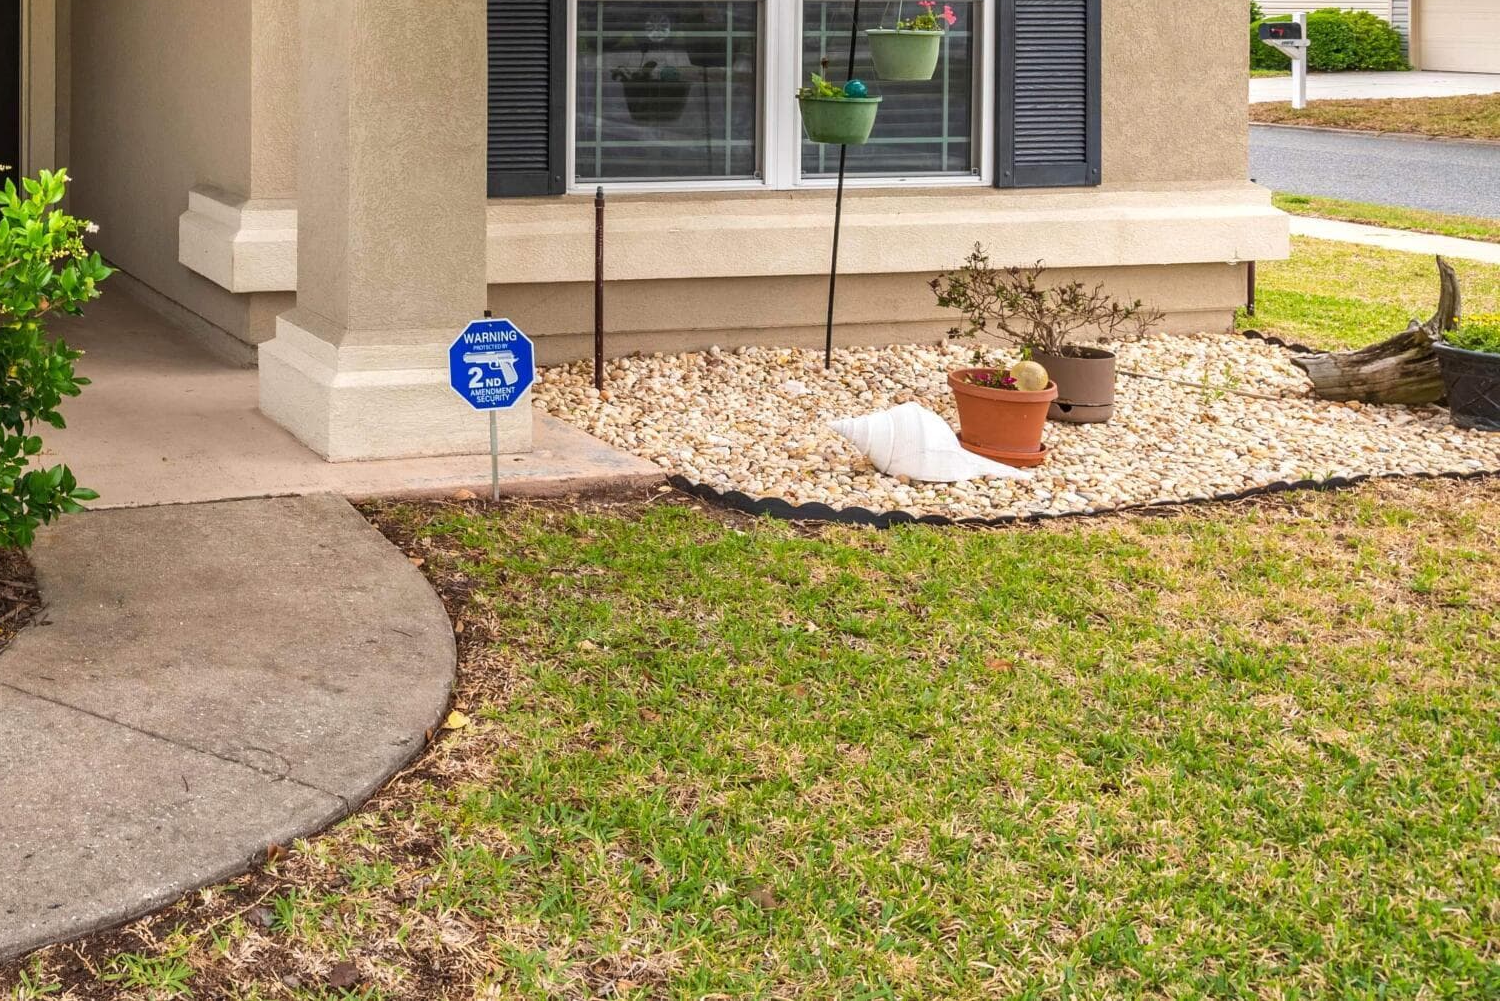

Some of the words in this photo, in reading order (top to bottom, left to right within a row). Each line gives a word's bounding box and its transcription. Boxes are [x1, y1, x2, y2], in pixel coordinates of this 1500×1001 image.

[464, 330, 517, 344] WARNING
[471, 387, 515, 396] AMENDMENT
[476, 394, 510, 403] SECURITY
